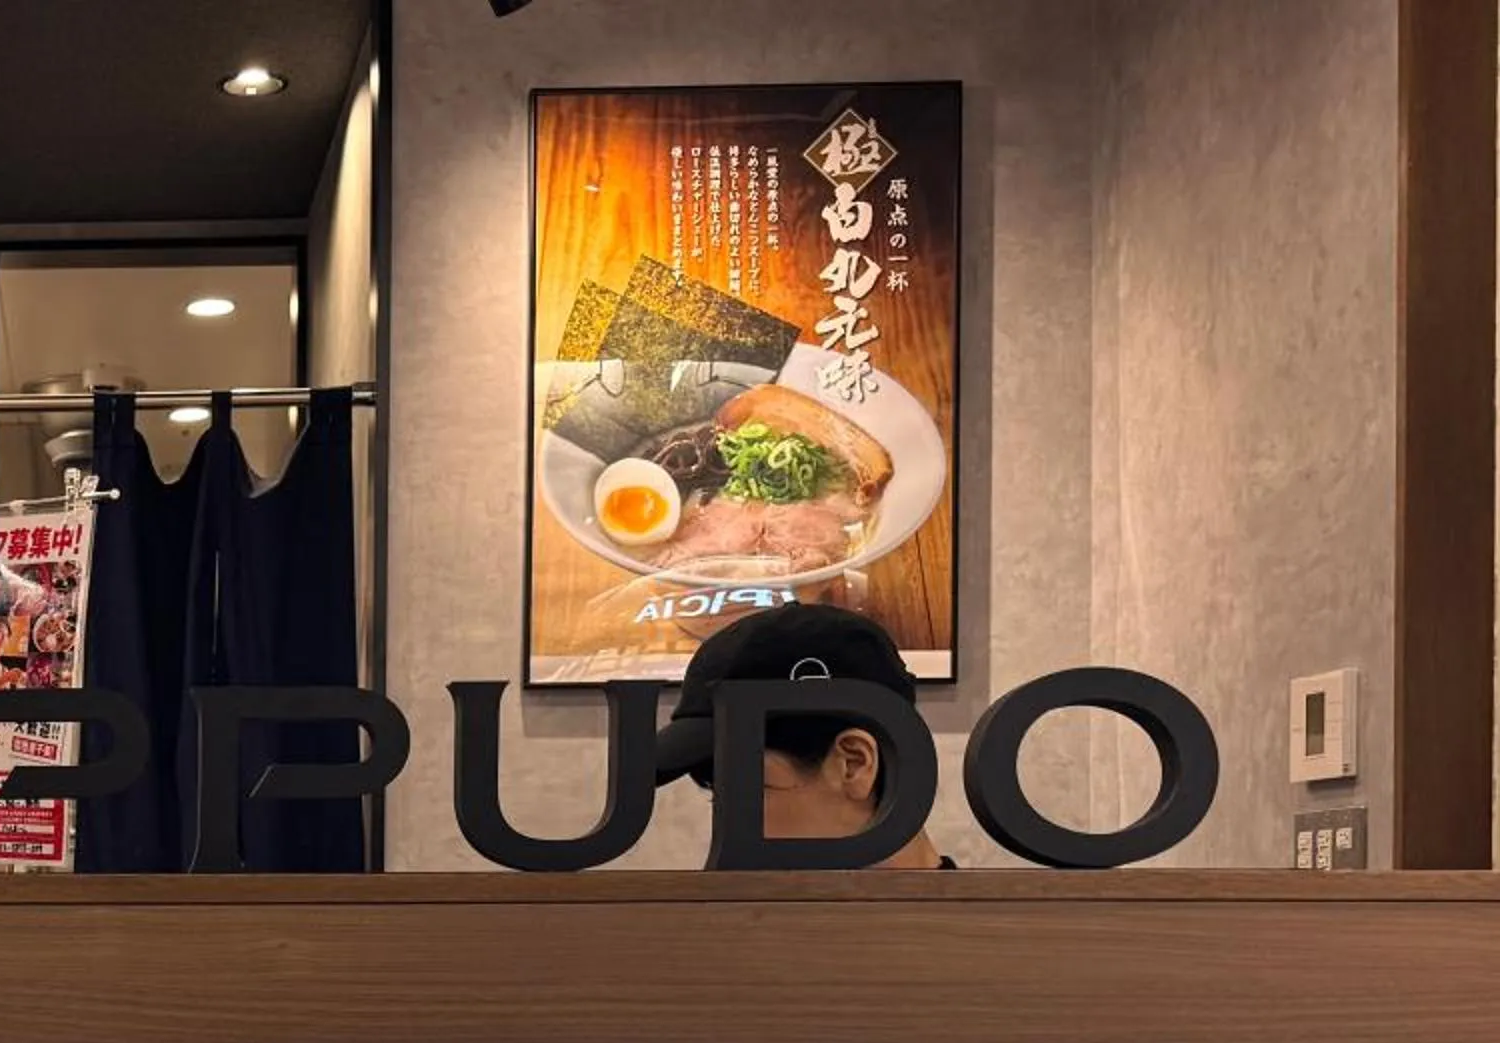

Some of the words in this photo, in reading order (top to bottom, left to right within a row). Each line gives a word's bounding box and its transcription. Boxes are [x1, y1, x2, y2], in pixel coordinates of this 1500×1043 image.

[887, 179, 909, 292] 原点の一杯
